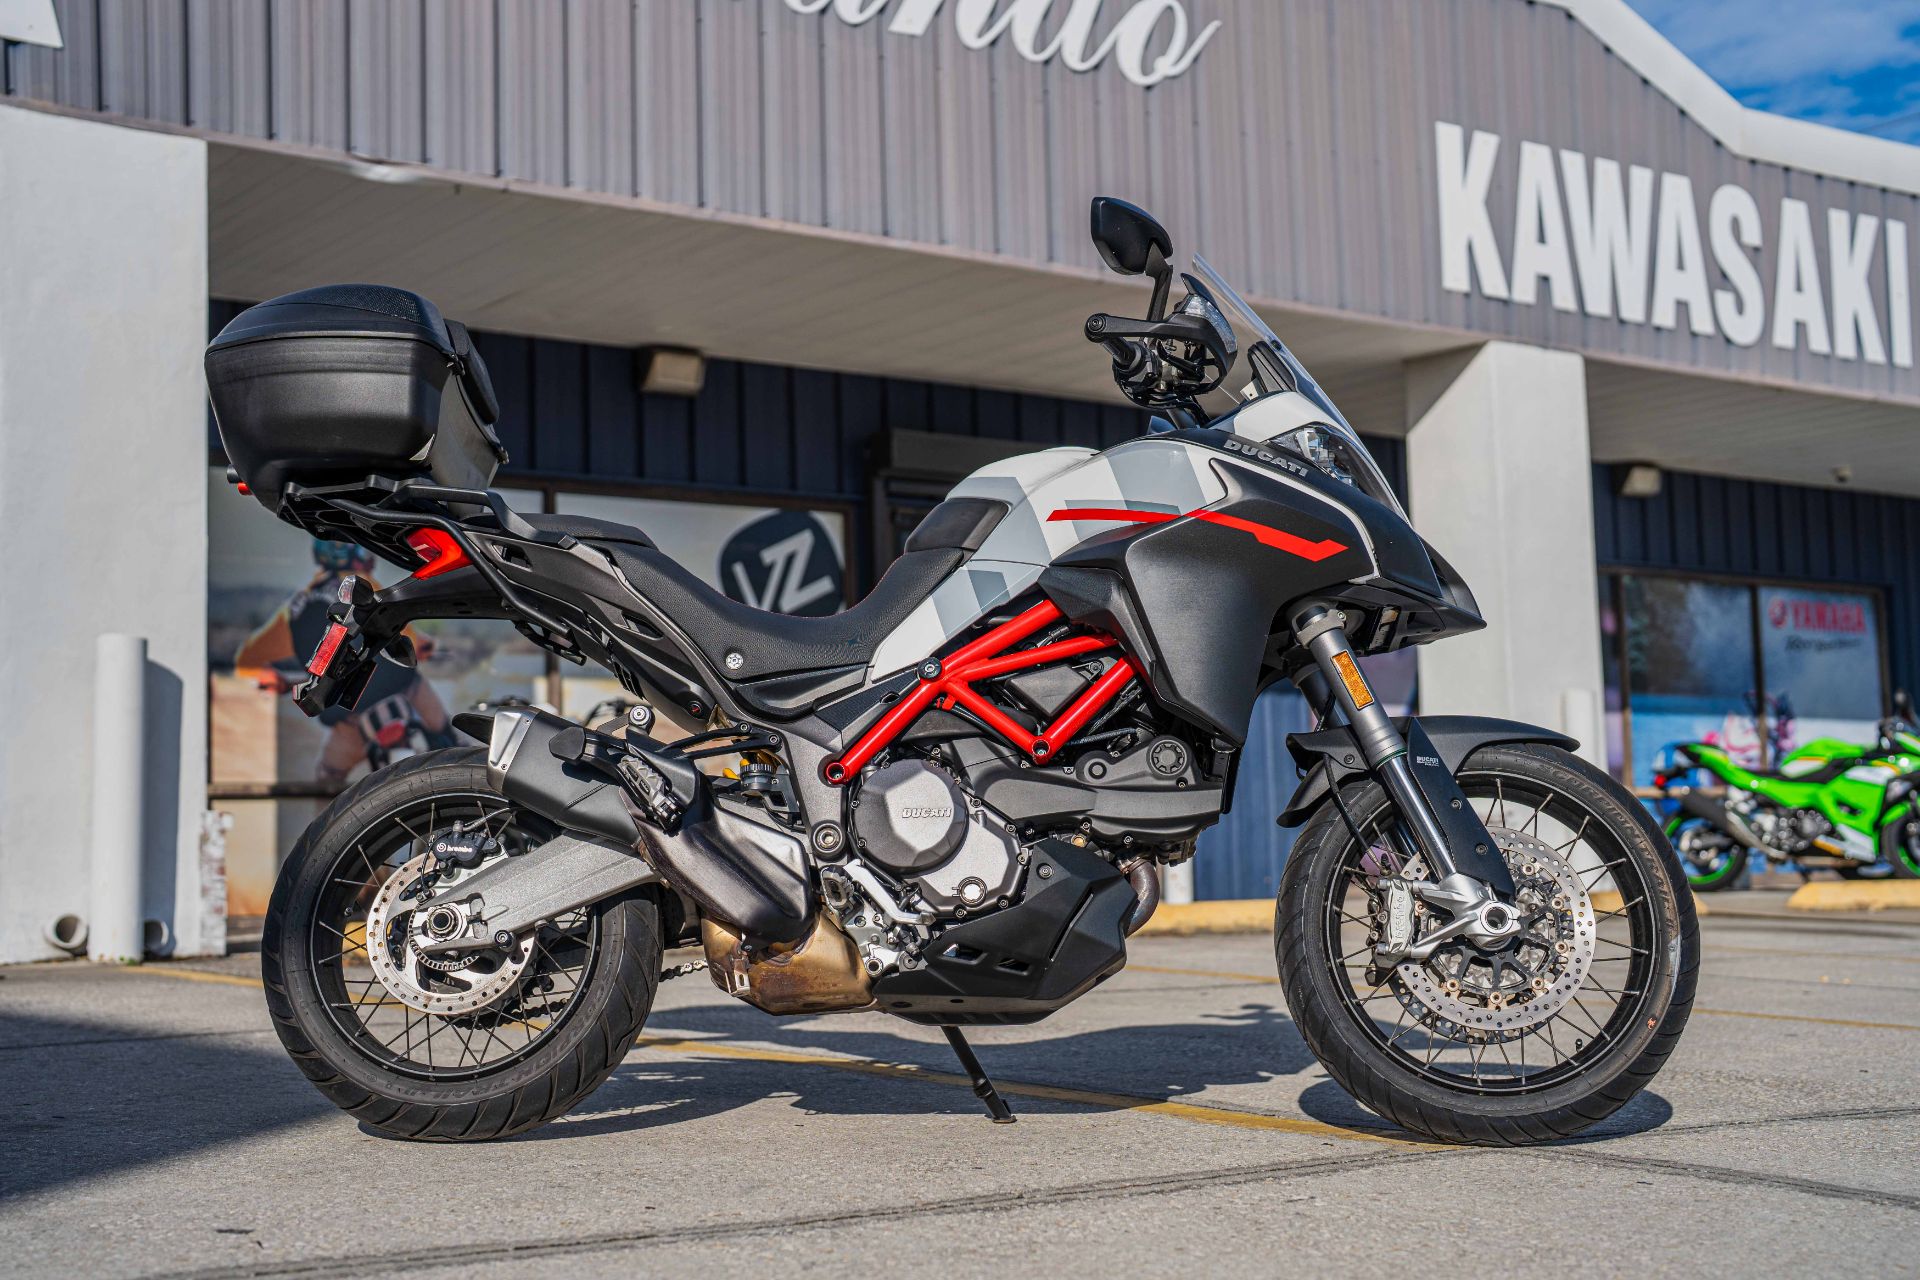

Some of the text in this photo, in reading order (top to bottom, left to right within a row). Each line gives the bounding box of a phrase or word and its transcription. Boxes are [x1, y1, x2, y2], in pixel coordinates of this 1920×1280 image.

[1435, 121, 1912, 368] KAWASAKI
[1224, 439, 1309, 477] DUCATI
[1790, 600, 1867, 633] YAMAHA
[1416, 755, 1439, 764] DUCATI
[902, 807, 952, 818] DUCATI
[446, 845, 473, 853] brembo
